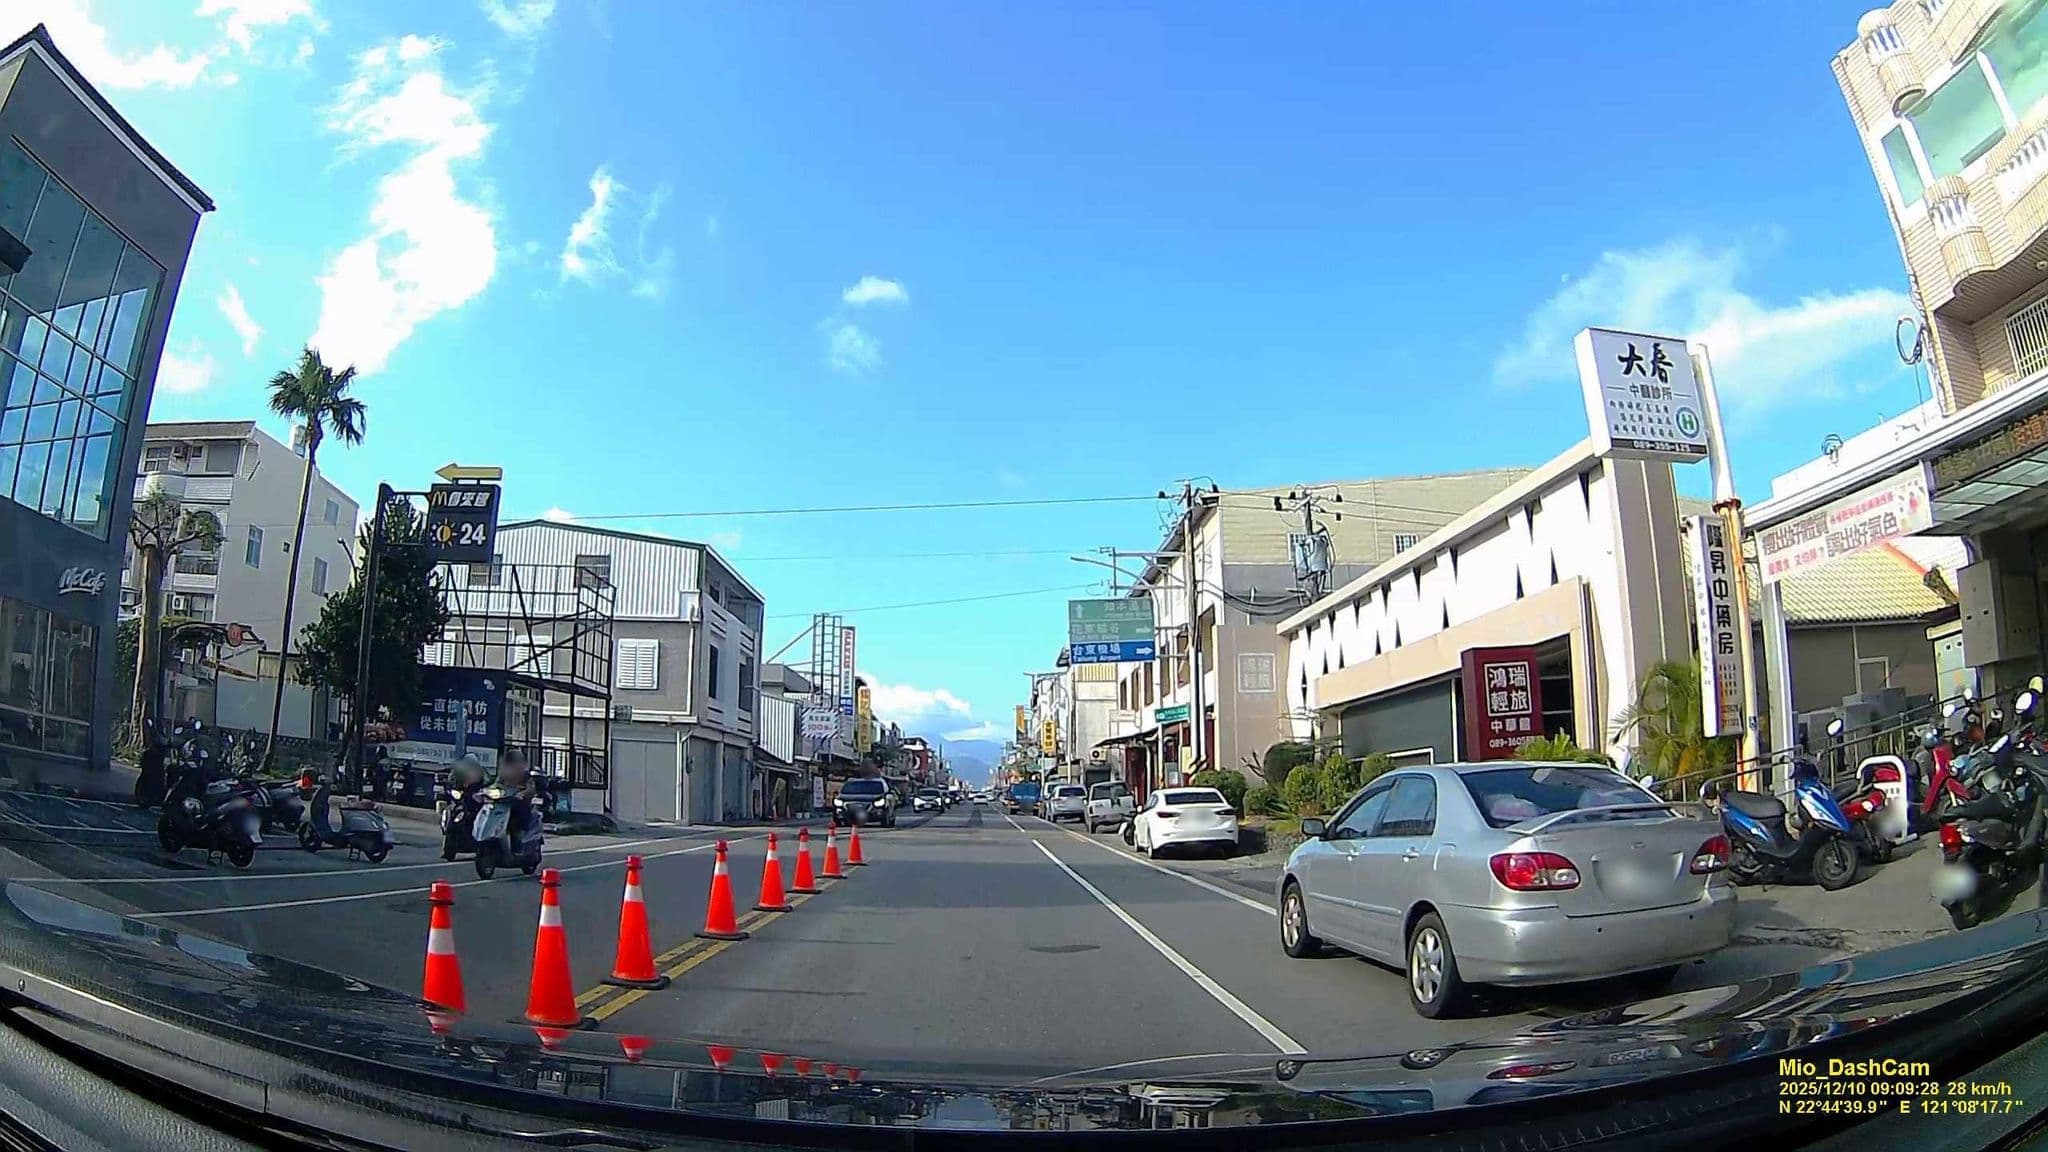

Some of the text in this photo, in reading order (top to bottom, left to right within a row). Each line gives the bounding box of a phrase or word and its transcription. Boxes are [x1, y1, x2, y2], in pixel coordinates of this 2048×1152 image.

[459, 523, 486, 545] 24
[1072, 643, 1121, 656] 台東機場
[1489, 666, 1526, 688] 鴻瑞
[1490, 689, 1529, 713] 輕旅
